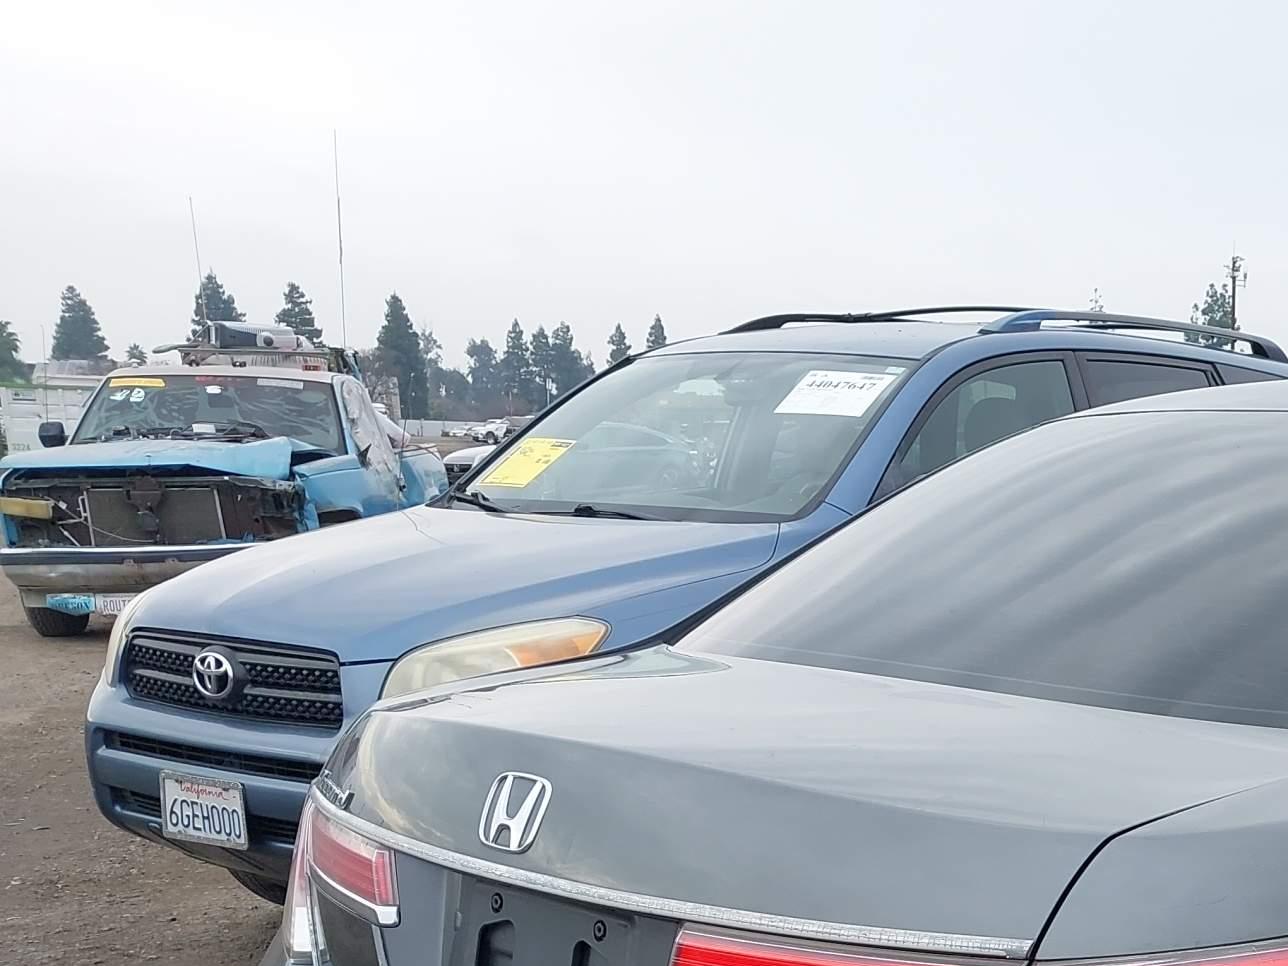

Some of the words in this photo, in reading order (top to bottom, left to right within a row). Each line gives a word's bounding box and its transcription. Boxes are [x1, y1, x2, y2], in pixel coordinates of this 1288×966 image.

[805, 380, 877, 391] 44047647
[102, 600, 131, 614] ROUT
[180, 781, 230, 799] California
[169, 797, 242, 839] 6GEH000
